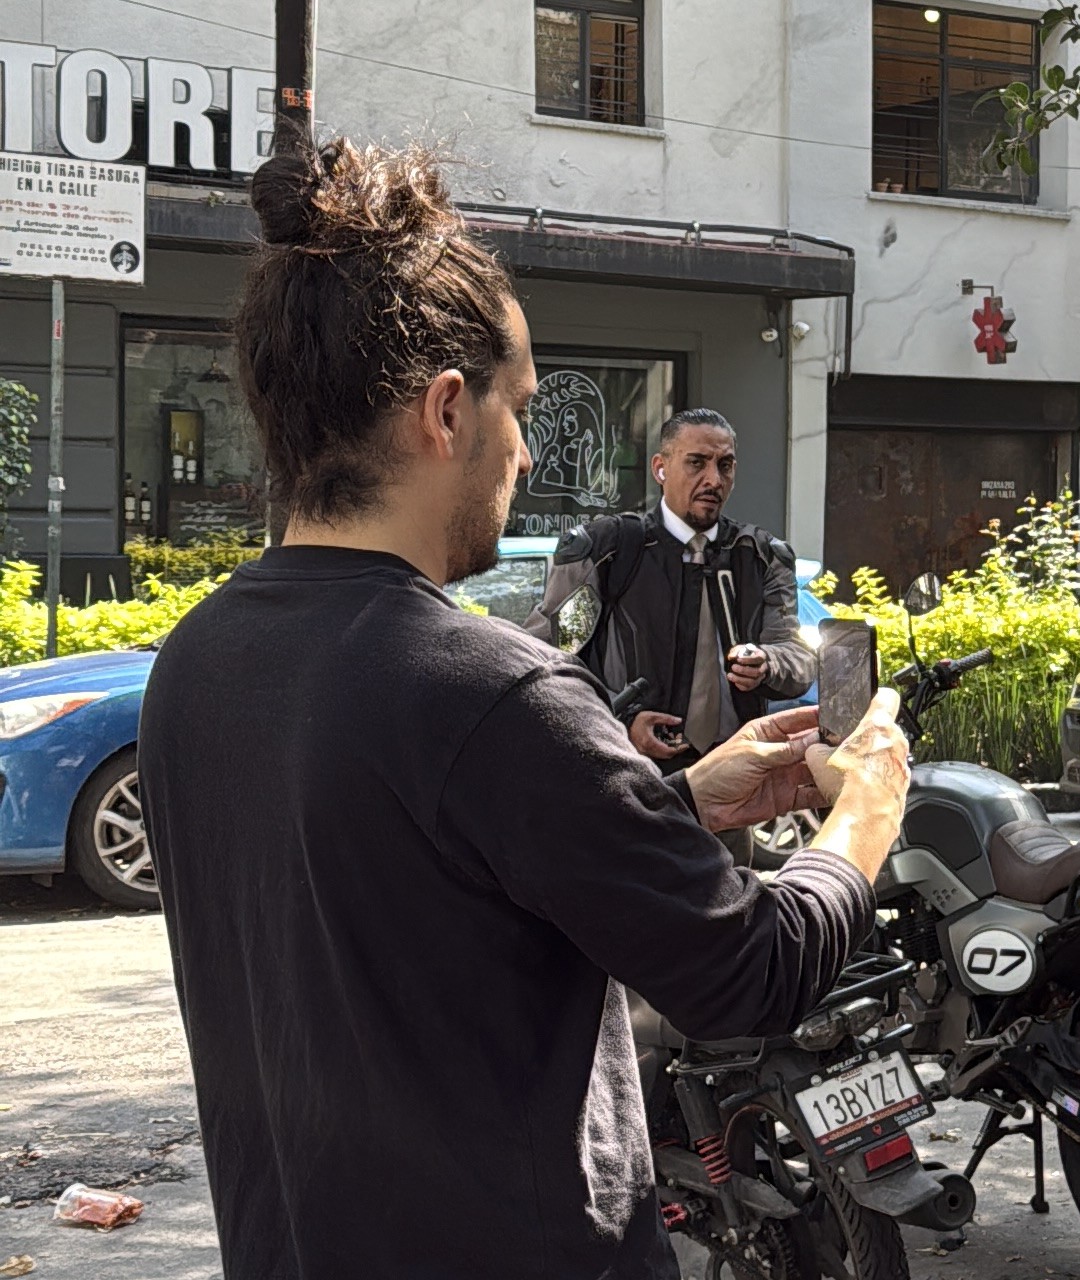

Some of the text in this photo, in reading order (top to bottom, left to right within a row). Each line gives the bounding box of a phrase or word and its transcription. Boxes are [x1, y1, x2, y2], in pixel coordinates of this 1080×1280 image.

[47, 162, 85, 179] TIRAR
[90, 166, 140, 185] BASURA
[17, 177, 98, 198] EN LA CALLE
[967, 947, 1027, 976] 07
[812, 1066, 905, 1131] 13BYZ7
